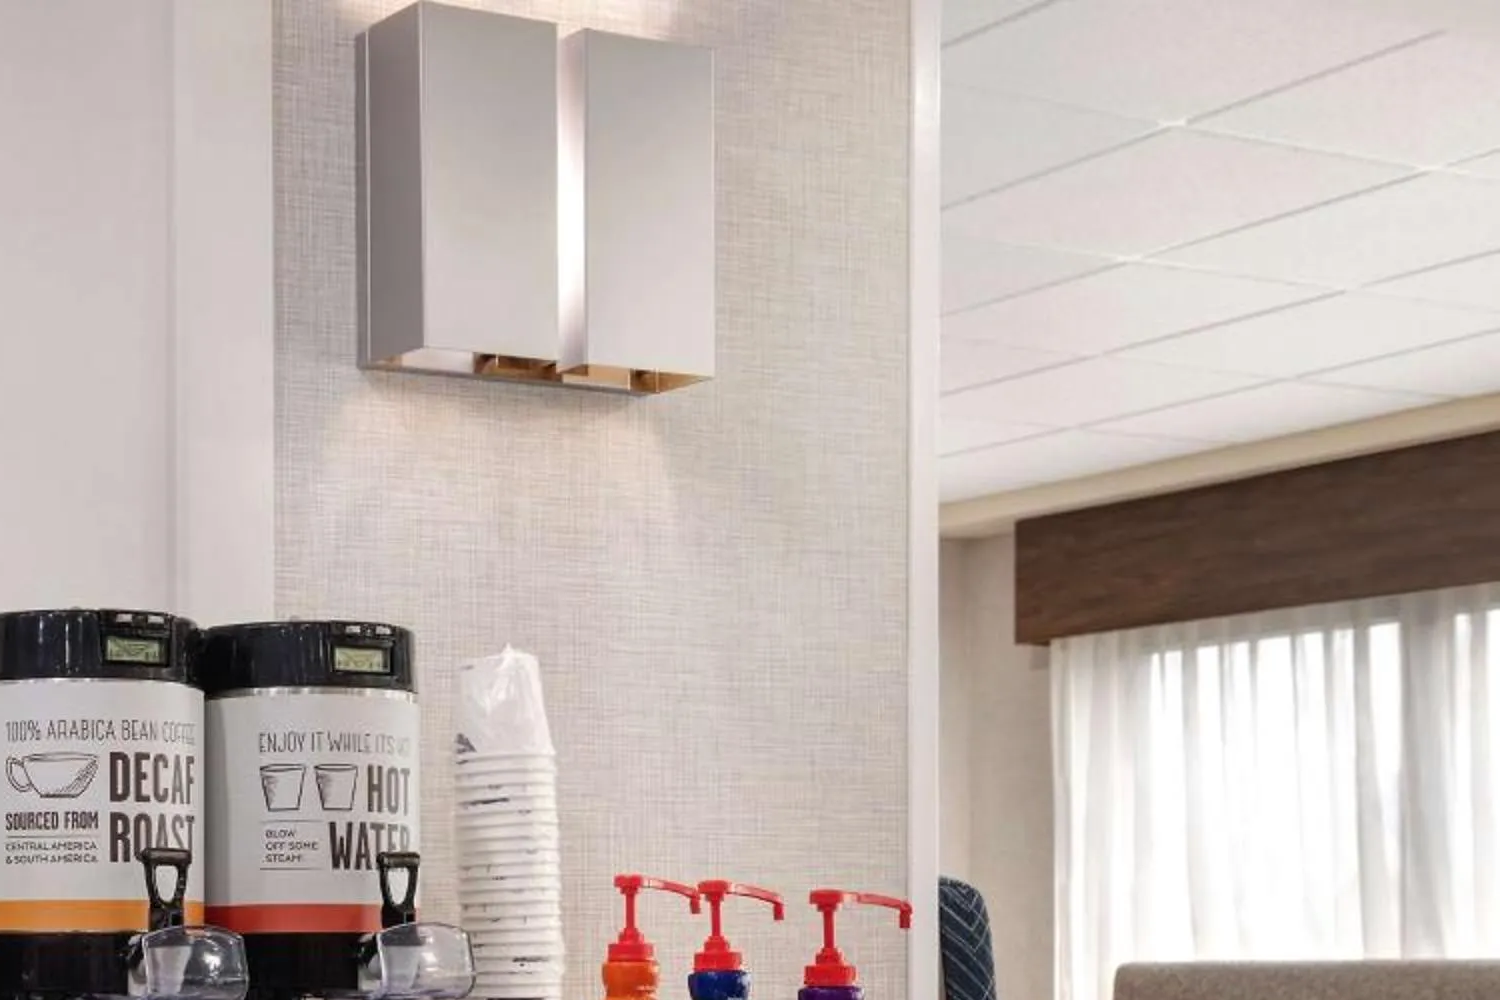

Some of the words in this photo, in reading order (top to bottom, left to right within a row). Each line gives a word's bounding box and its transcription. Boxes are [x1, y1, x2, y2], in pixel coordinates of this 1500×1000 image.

[5, 720, 41, 743] 100%
[47, 719, 116, 741] ARABICA
[122, 720, 158, 741] BEAN
[259, 731, 306, 753] ENJOY
[311, 731, 324, 753] IT
[327, 731, 371, 753] WHILE
[109, 751, 195, 805] DECAF
[367, 764, 410, 816] HOT
[5, 811, 59, 831] SOURCED
[64, 811, 99, 830] FROM
[5, 841, 49, 852] CENTRAL
[51, 841, 98, 851] AMERICA
[109, 811, 195, 863] ROAST
[265, 841, 286, 851] OFF
[288, 841, 319, 851] SOME
[328, 821, 411, 871] WATER
[50, 853, 98, 864] AMERICA
[265, 853, 301, 863] STEAM
